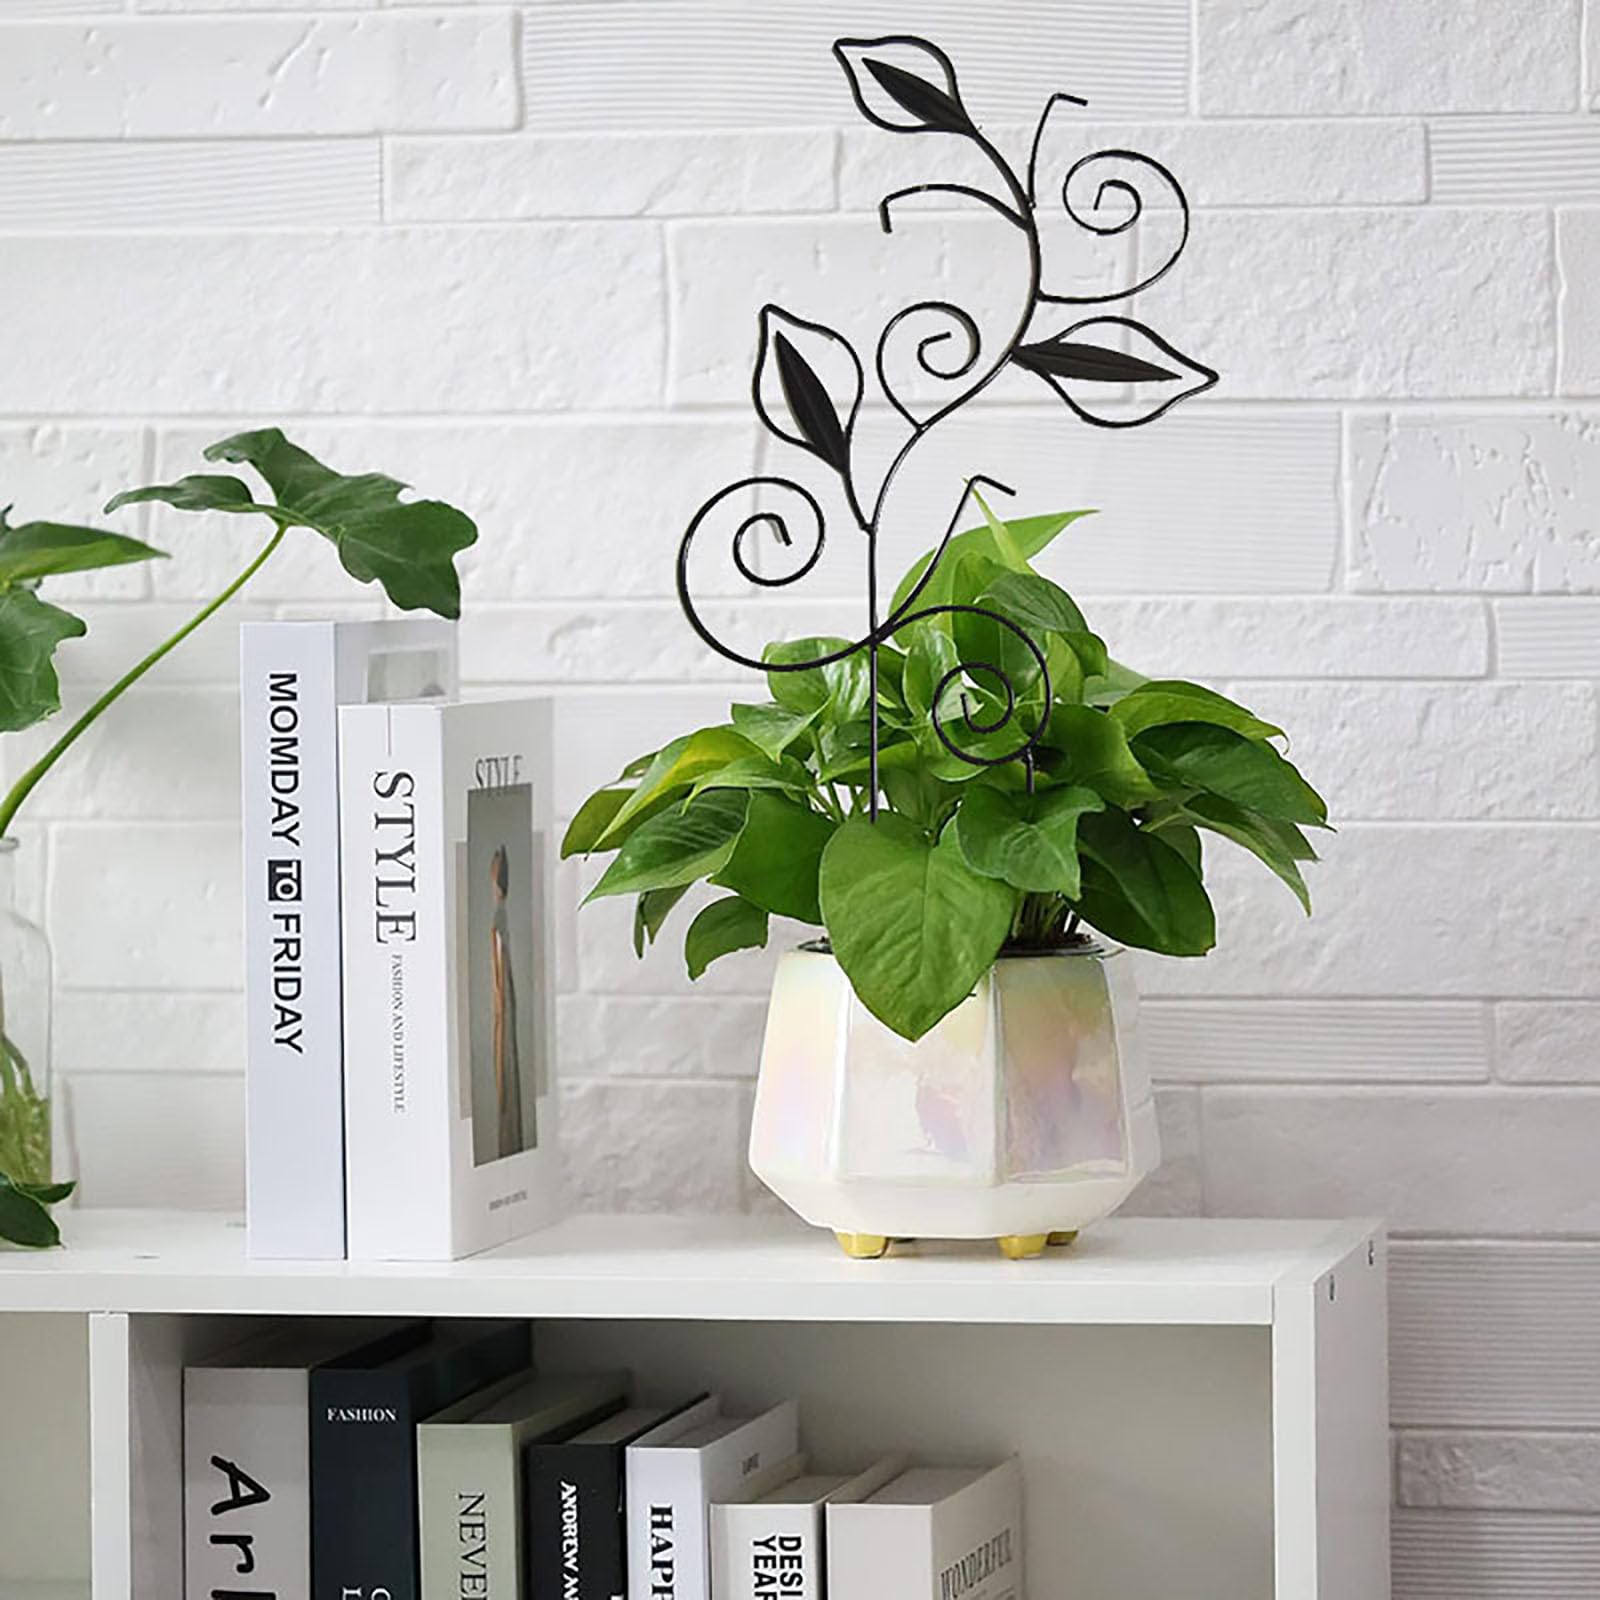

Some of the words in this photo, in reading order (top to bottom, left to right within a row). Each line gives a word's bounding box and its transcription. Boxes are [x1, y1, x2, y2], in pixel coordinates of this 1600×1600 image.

[269, 673, 303, 846] MOMDAY
[268, 860, 303, 901] TO
[373, 771, 417, 944] STYLE
[271, 912, 304, 1054] FRIDAY
[391, 953, 404, 1010] FASHION
[392, 1012, 404, 1041] AND
[392, 1043, 405, 1113] LIFESTYLE
[327, 1408, 396, 1422] FASHION
[209, 1455, 277, 1600] Ar
[458, 1493, 488, 1600] NEVE
[560, 1481, 579, 1571] ANDREW
